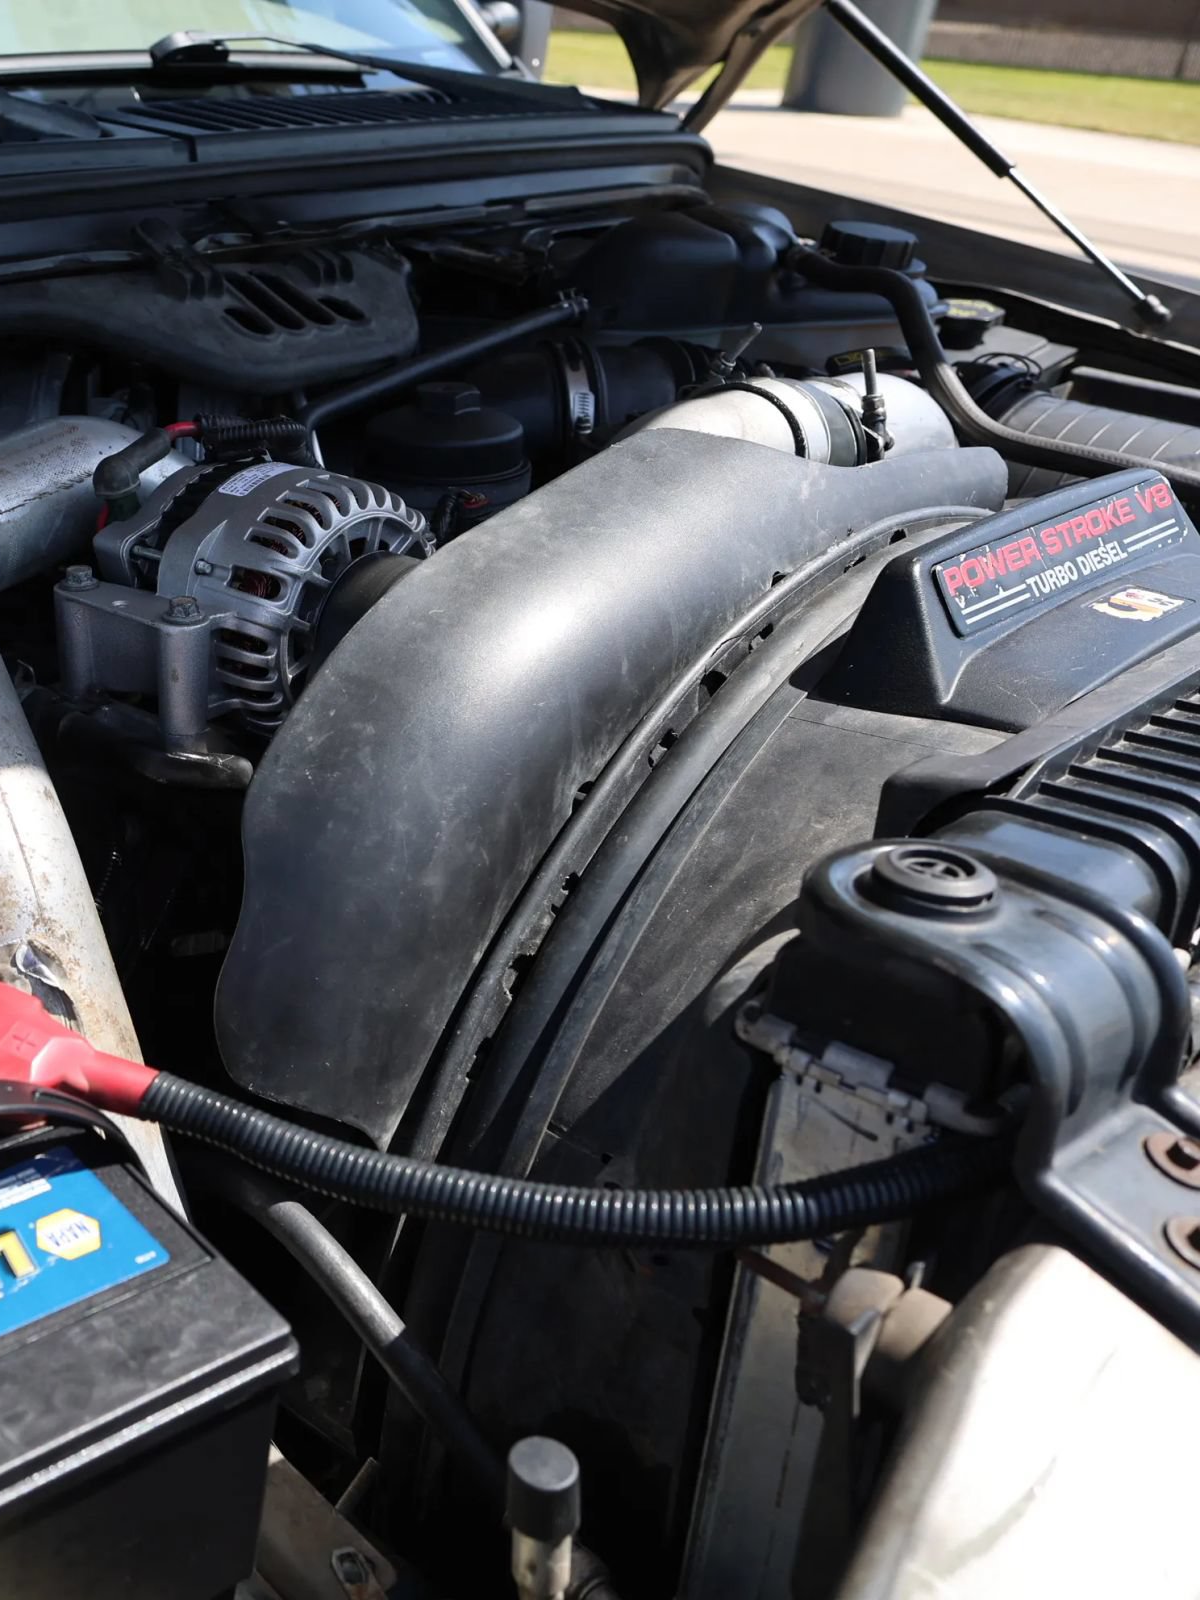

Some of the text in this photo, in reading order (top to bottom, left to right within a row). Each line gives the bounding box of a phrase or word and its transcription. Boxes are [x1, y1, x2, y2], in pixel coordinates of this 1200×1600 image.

[943, 483, 1174, 597] POWER STROKE V8
[1026, 541, 1128, 597] TURBO DIESEL
[47, 1220, 90, 1247] NAPA
